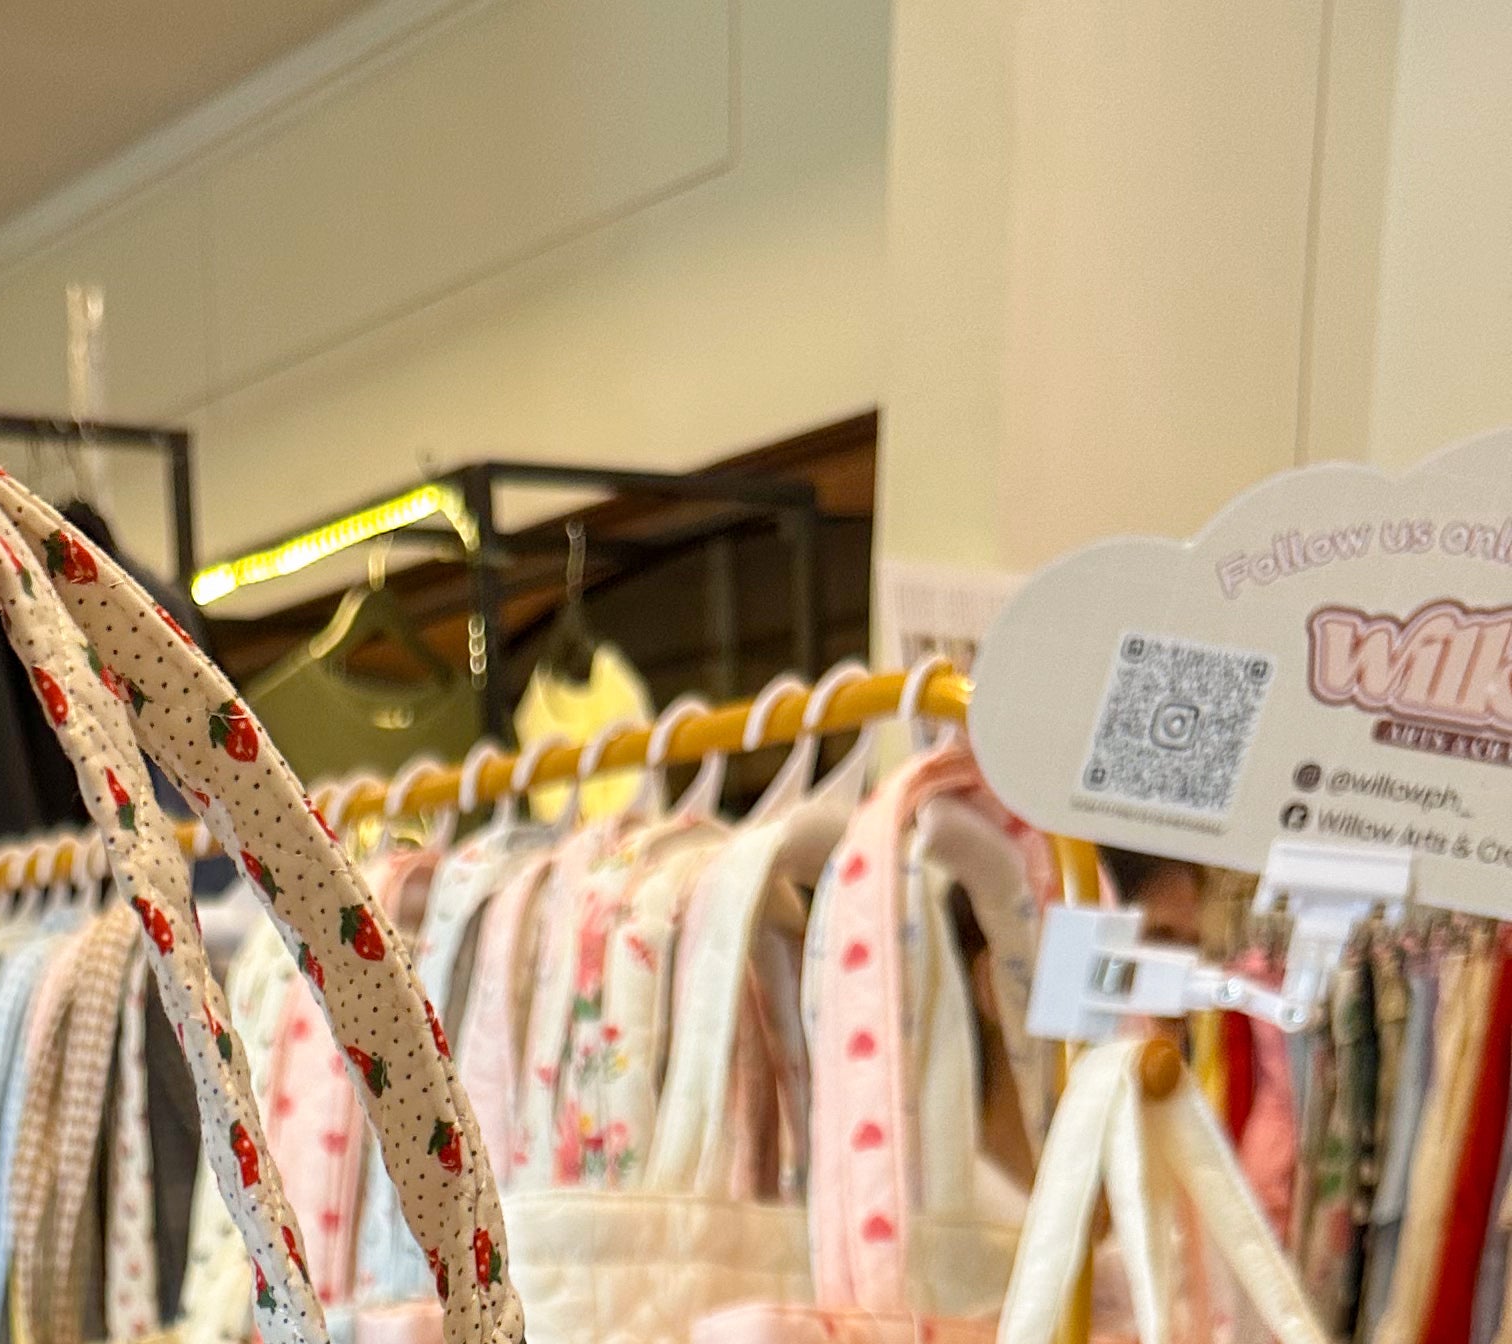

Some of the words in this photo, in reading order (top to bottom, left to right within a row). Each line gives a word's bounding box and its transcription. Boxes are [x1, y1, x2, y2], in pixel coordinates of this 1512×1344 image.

[1215, 522, 1373, 600] Follow
[1378, 517, 1436, 554] us
[1317, 805, 1396, 842] Willow
[1397, 822, 1448, 855] Arts
[1451, 832, 1474, 859] &
